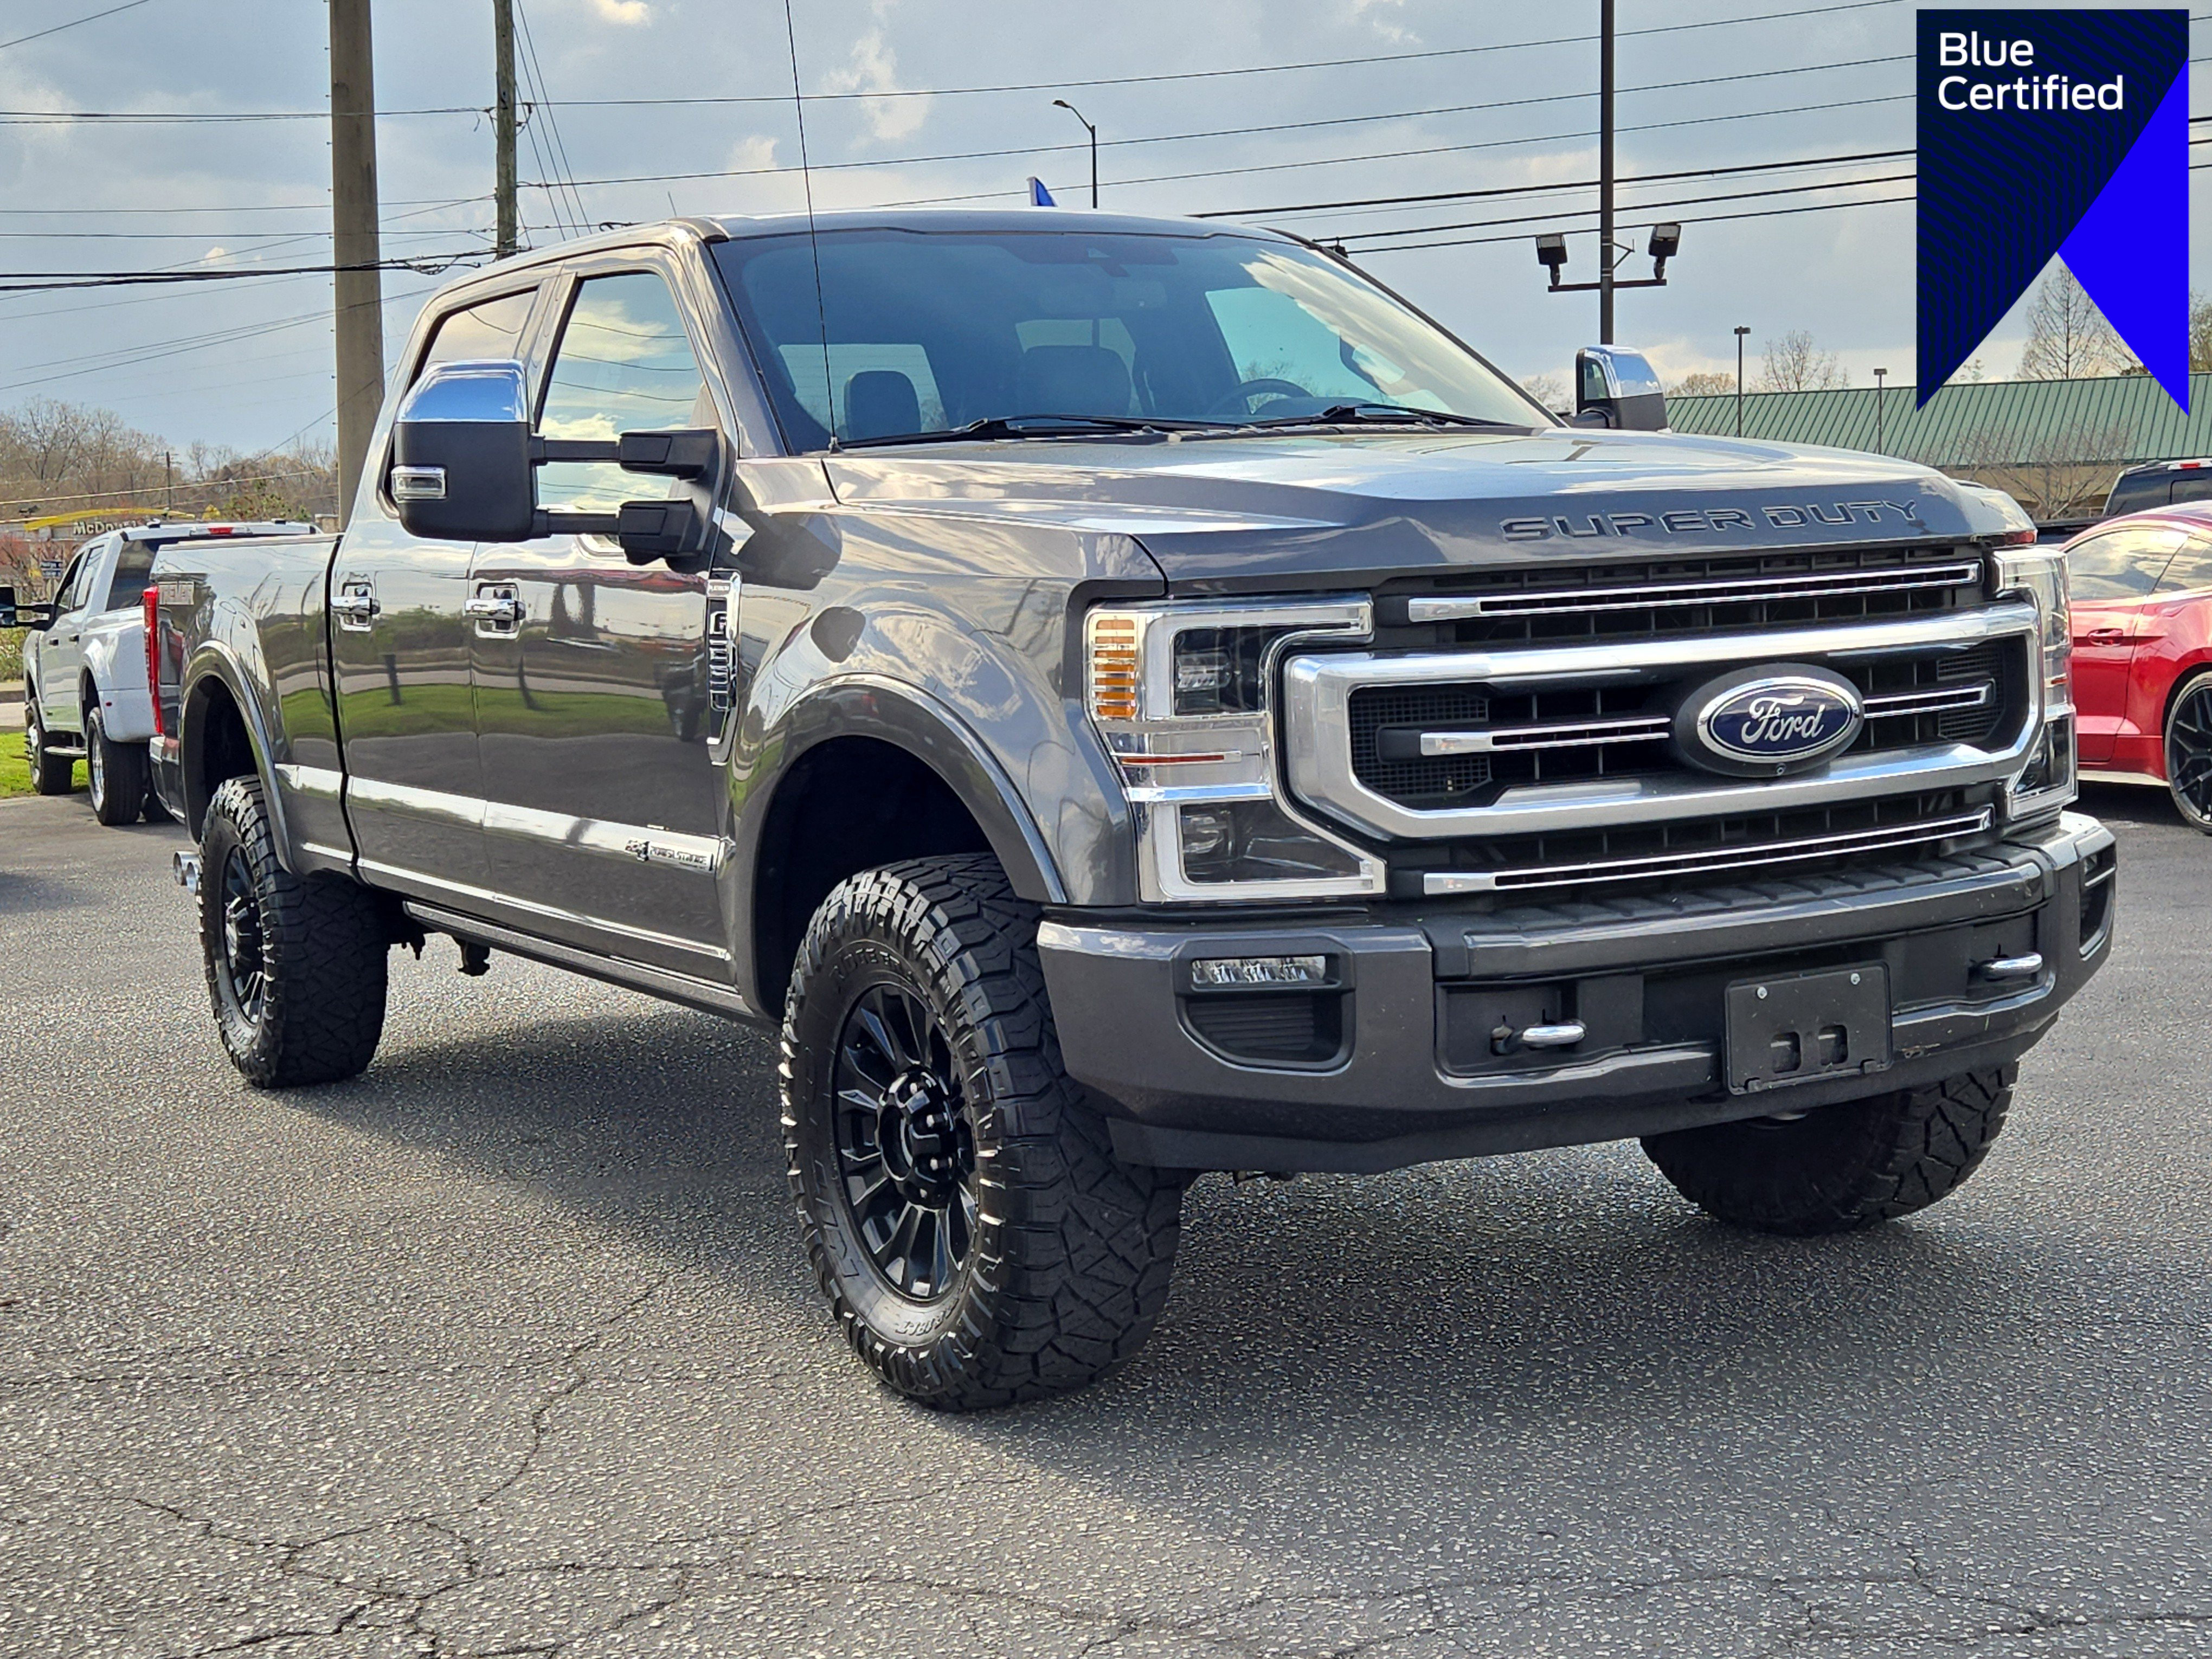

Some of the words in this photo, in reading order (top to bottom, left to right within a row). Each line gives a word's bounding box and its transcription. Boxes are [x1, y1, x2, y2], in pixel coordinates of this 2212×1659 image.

[1500, 508, 1756, 542] SUPER
[1761, 499, 1917, 529] DUTY
[1741, 695, 1826, 745] Ford
